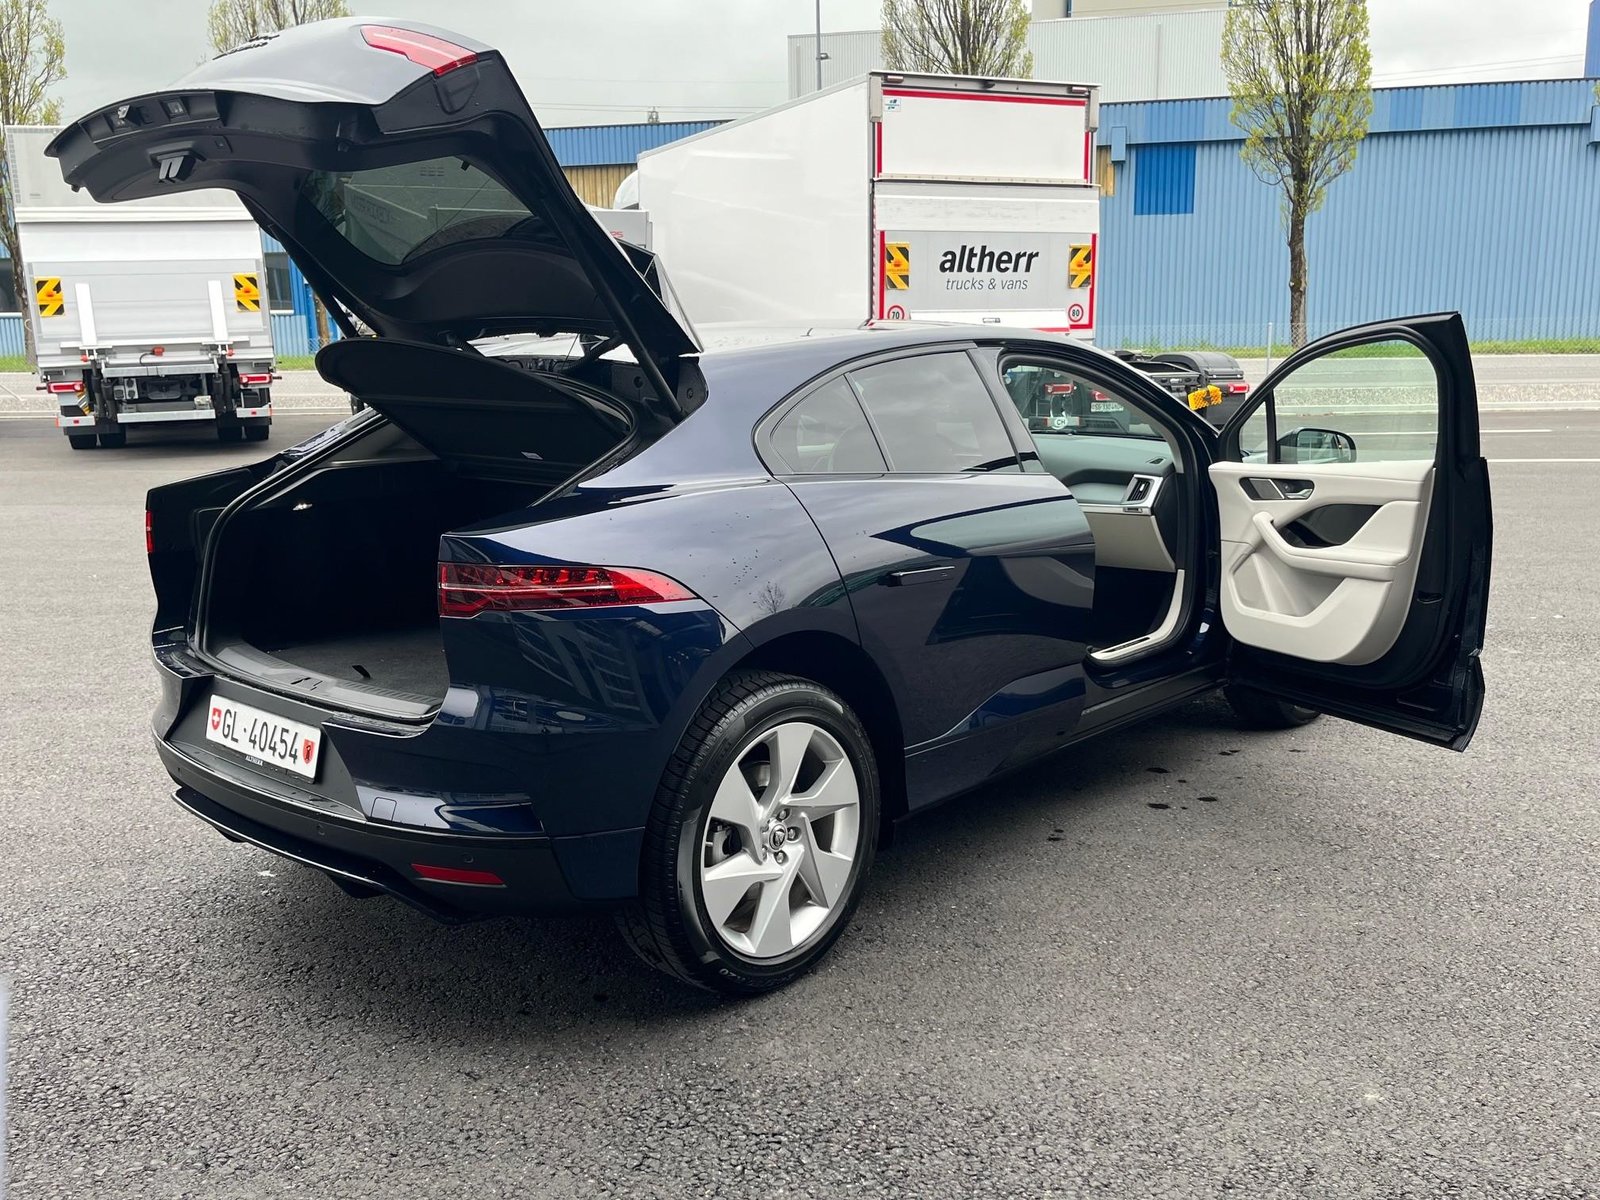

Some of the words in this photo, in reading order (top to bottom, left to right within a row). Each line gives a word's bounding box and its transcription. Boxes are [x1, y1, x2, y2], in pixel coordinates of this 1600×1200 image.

[939, 244, 1040, 273] altherr
[946, 277, 985, 290] trucks
[987, 276, 997, 290] &
[1001, 279, 1029, 290] vans
[891, 311, 900, 320] 70
[1072, 309, 1080, 317] 80
[222, 708, 239, 743] GL
[248, 718, 299, 764] 40454
